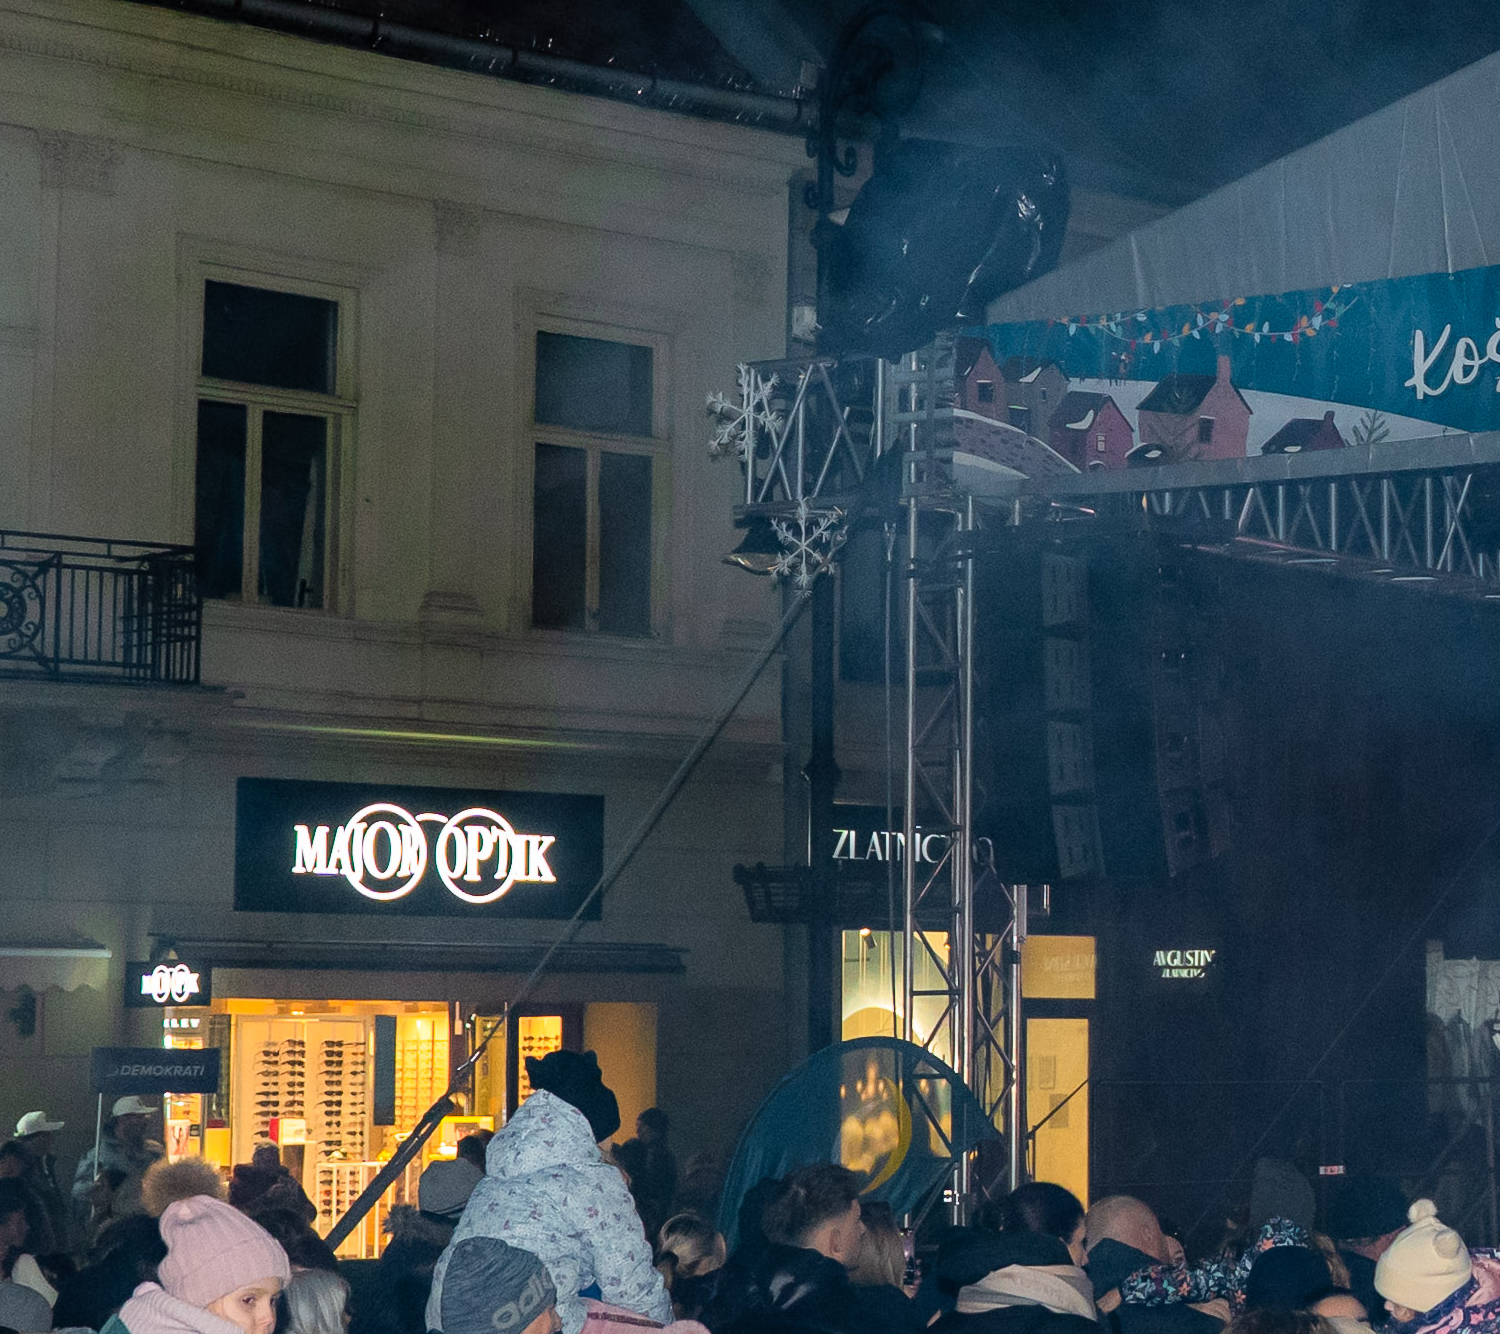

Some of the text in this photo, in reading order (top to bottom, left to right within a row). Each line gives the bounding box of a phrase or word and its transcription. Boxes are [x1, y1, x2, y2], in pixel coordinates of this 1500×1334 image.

[292, 819, 557, 883] MAJOR OPTIK
[120, 1064, 205, 1077] DEMOKRATI
